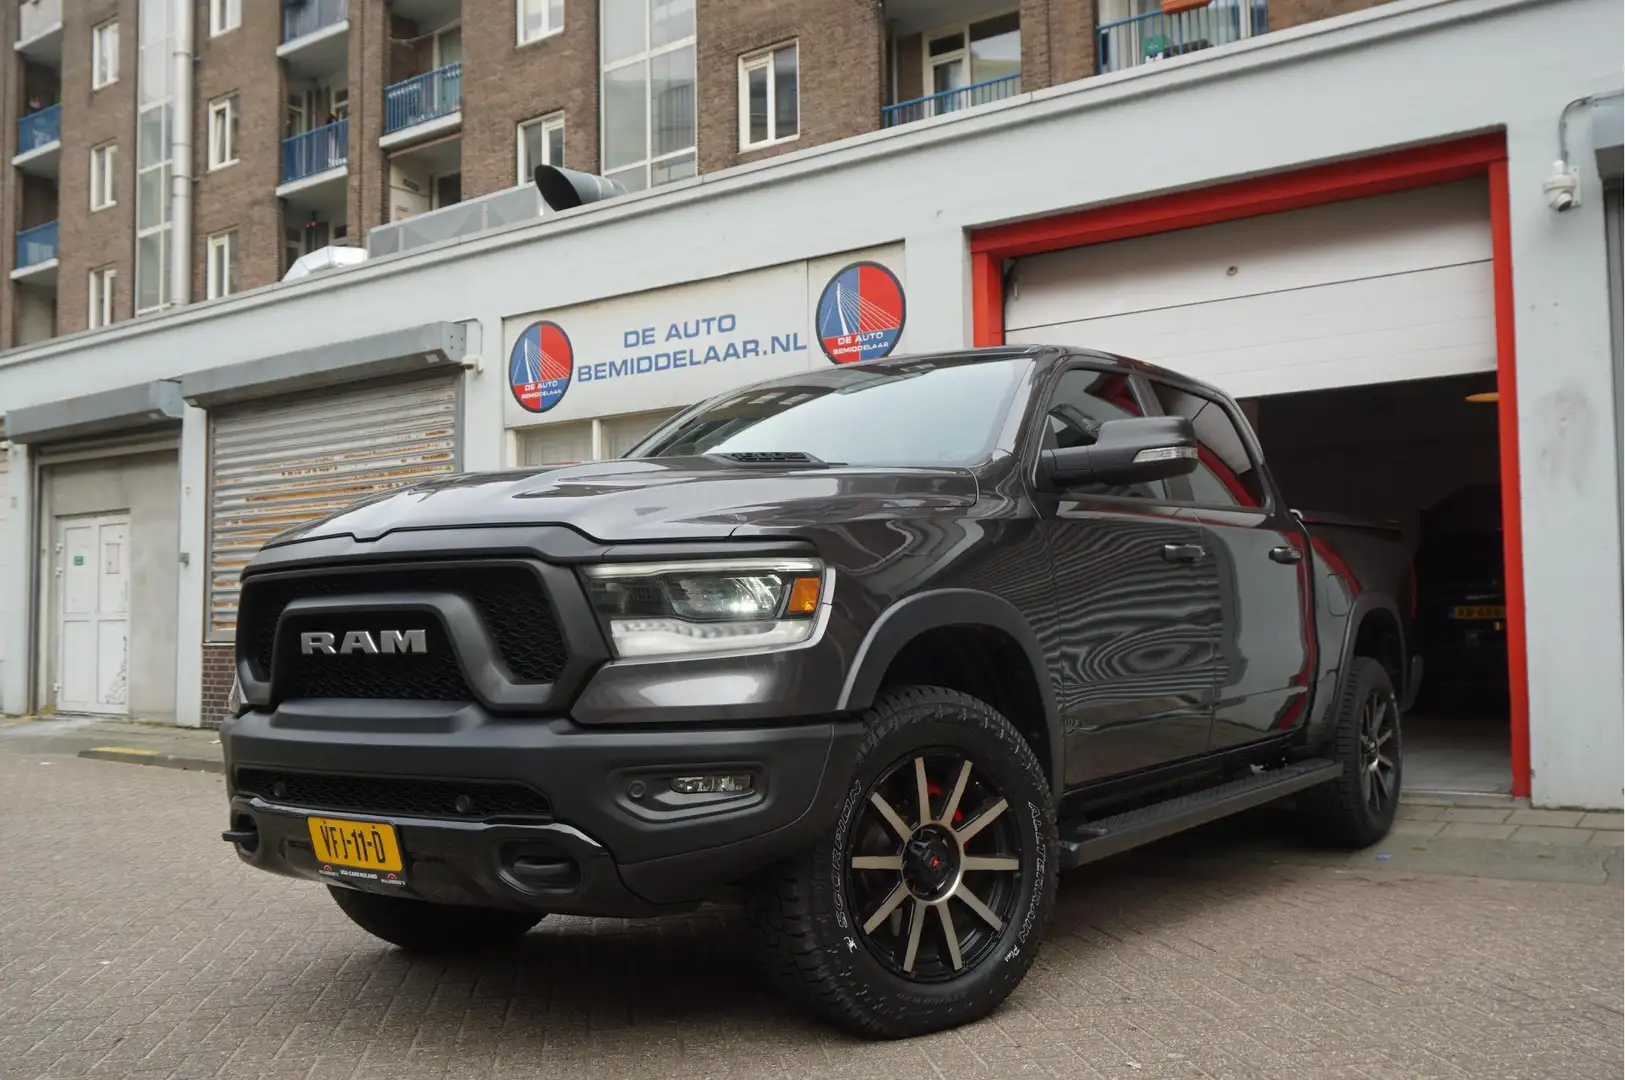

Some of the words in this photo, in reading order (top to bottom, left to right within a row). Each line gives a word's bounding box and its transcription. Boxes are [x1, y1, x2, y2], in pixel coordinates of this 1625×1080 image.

[623, 327, 655, 349] DE
[664, 313, 736, 341] AUTO
[837, 336, 852, 346] DE
[855, 331, 884, 343] AUTO
[577, 332, 808, 383] BEMIDDELAAR.NL
[832, 341, 889, 355] BEMIDDELAAR
[521, 388, 562, 399] BEMIDDELAAR
[524, 383, 536, 391] DE
[537, 380, 558, 389] AUTO
[300, 629, 427, 654] RAM
[320, 825, 386, 863] VFJ-11-D
[831, 779, 861, 928] SCORPION
